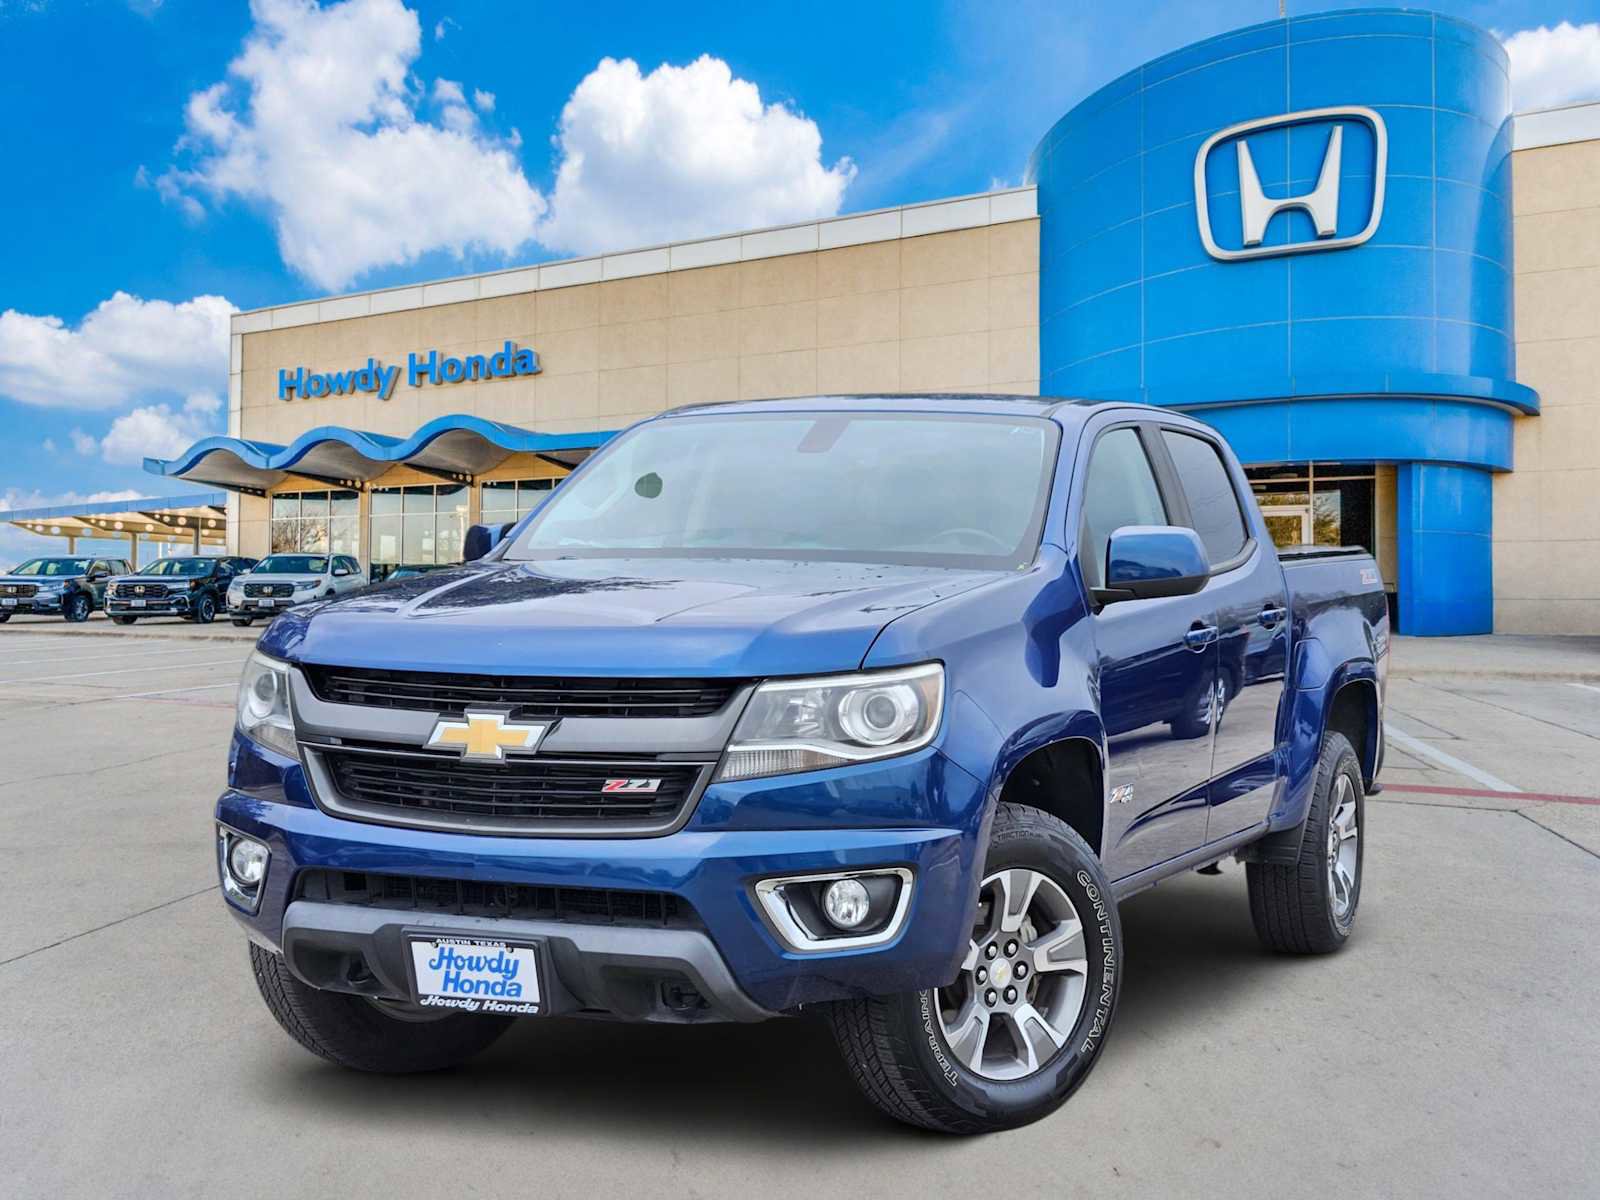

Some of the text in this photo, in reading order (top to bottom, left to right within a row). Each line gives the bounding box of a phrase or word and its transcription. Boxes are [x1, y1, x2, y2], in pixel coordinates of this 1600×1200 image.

[277, 339, 543, 401] Howdy Honda
[601, 779, 662, 793] Z71
[436, 938, 471, 946] AUSTIN
[428, 946, 520, 980] Howdy
[1076, 870, 1115, 1053] CONTINENTAL
[442, 970, 523, 998] Honda
[420, 995, 539, 1014] Howdy Honda
